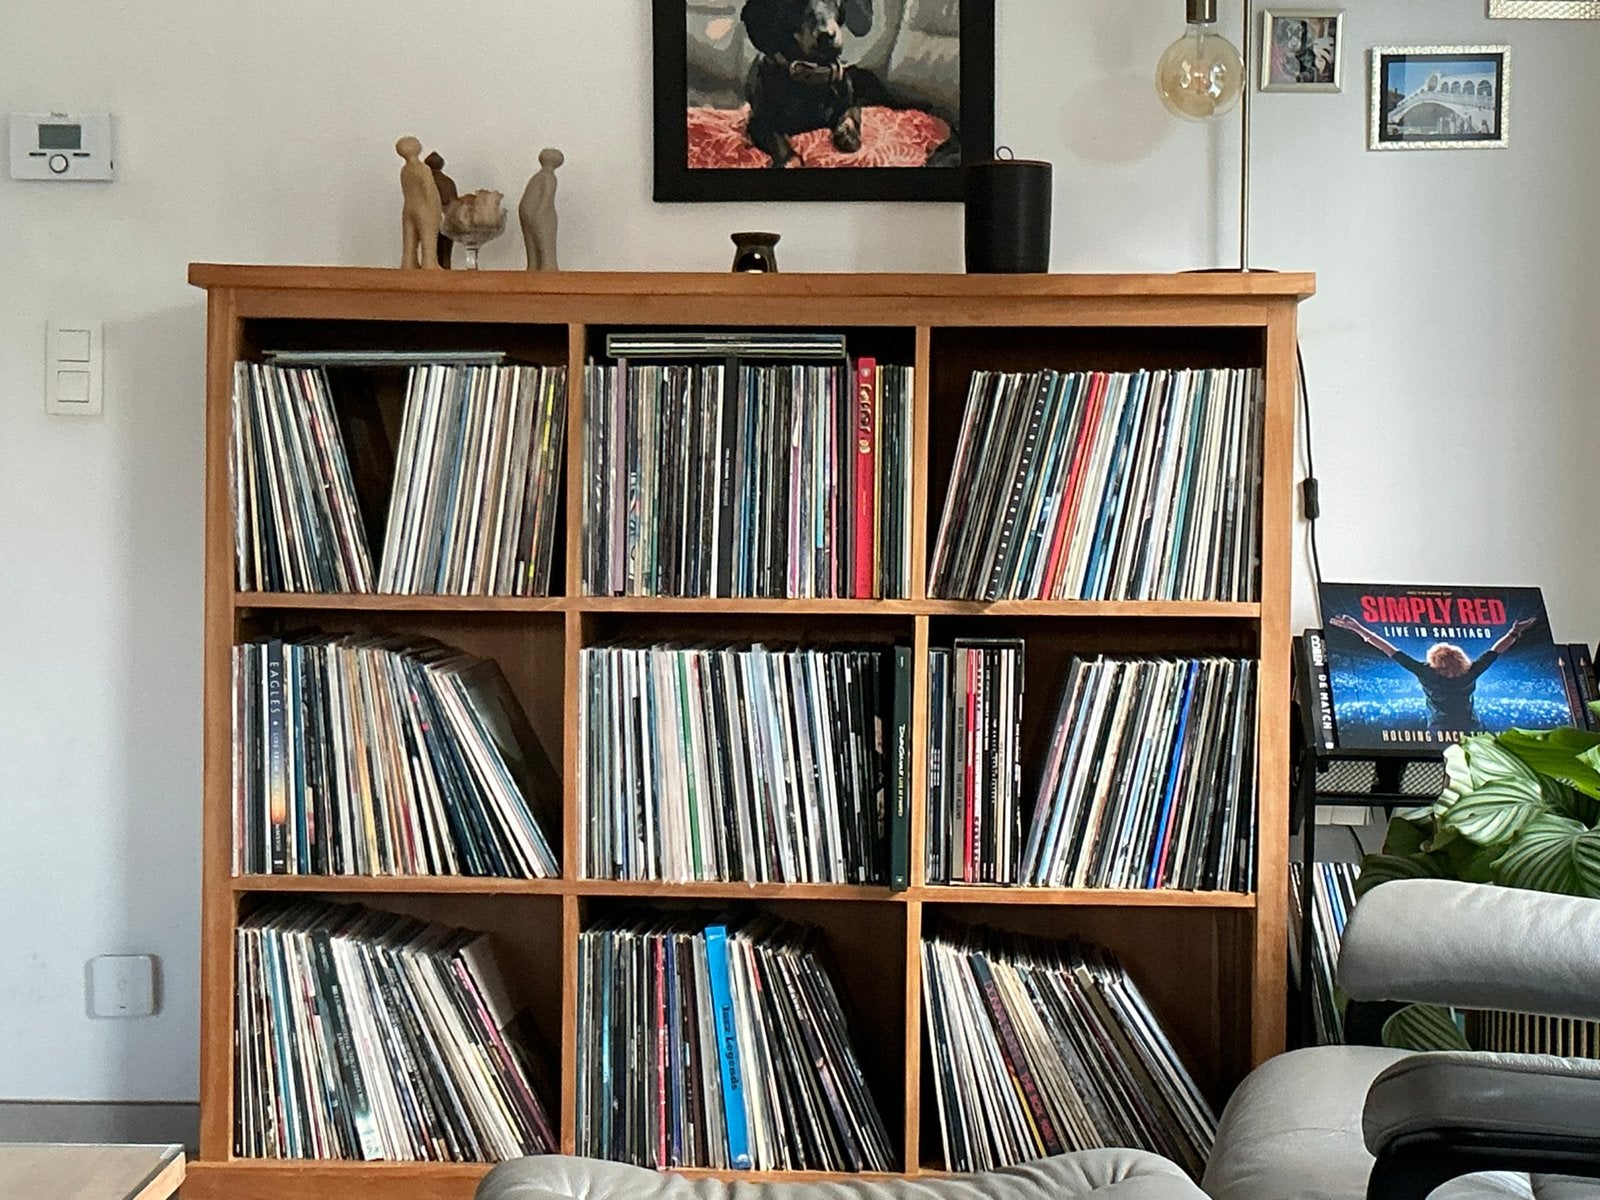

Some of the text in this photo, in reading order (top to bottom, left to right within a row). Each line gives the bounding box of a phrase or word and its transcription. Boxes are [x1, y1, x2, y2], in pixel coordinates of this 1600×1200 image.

[1360, 595, 1507, 625] SIMPLY RED
[1384, 626, 1492, 639] LIVE IN SANTIAGO
[269, 661, 281, 714] EAGLES
[1318, 674, 1328, 689] DE
[1319, 692, 1333, 730] MATCH
[1382, 730, 1432, 742] HOLDING
[722, 1005, 739, 1091] Jazz Legends
[985, 981, 1007, 1025] DONNA
[1019, 1072, 1035, 1093] THE
[1029, 1094, 1043, 1117] BOX
